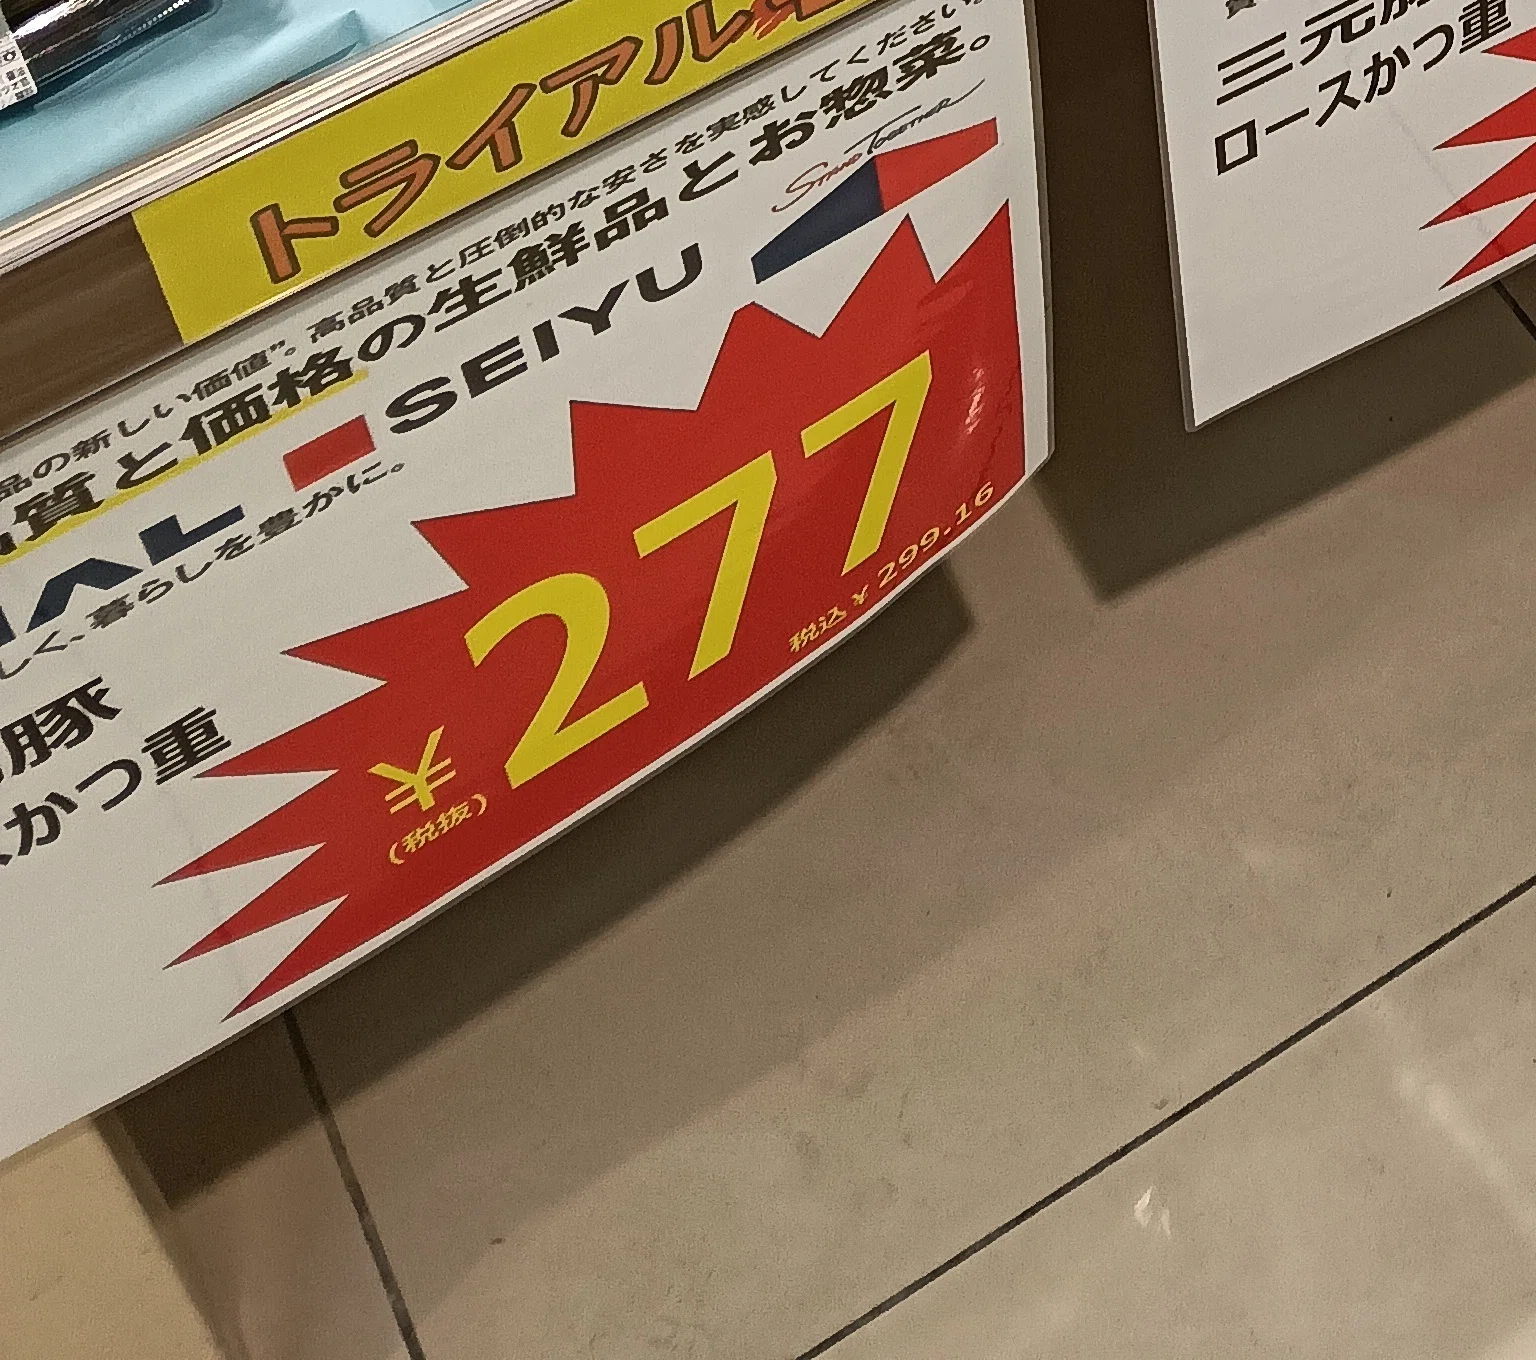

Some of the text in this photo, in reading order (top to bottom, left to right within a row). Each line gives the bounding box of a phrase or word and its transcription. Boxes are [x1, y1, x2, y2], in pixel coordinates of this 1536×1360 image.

[0, 25, 991, 555] 質と価格の生鮮品とお惣菜。
[385, 241, 704, 436] SEIYU
[0, 459, 406, 679] しく、暮らしを豊かに。
[367, 350, 933, 817] ¥ 277
[787, 602, 848, 656] 税込
[876, 479, 996, 585] 299.16
[0, 675, 123, 784] 豚
[0, 705, 233, 867] かつ重
[388, 792, 489, 868] (税抜)
